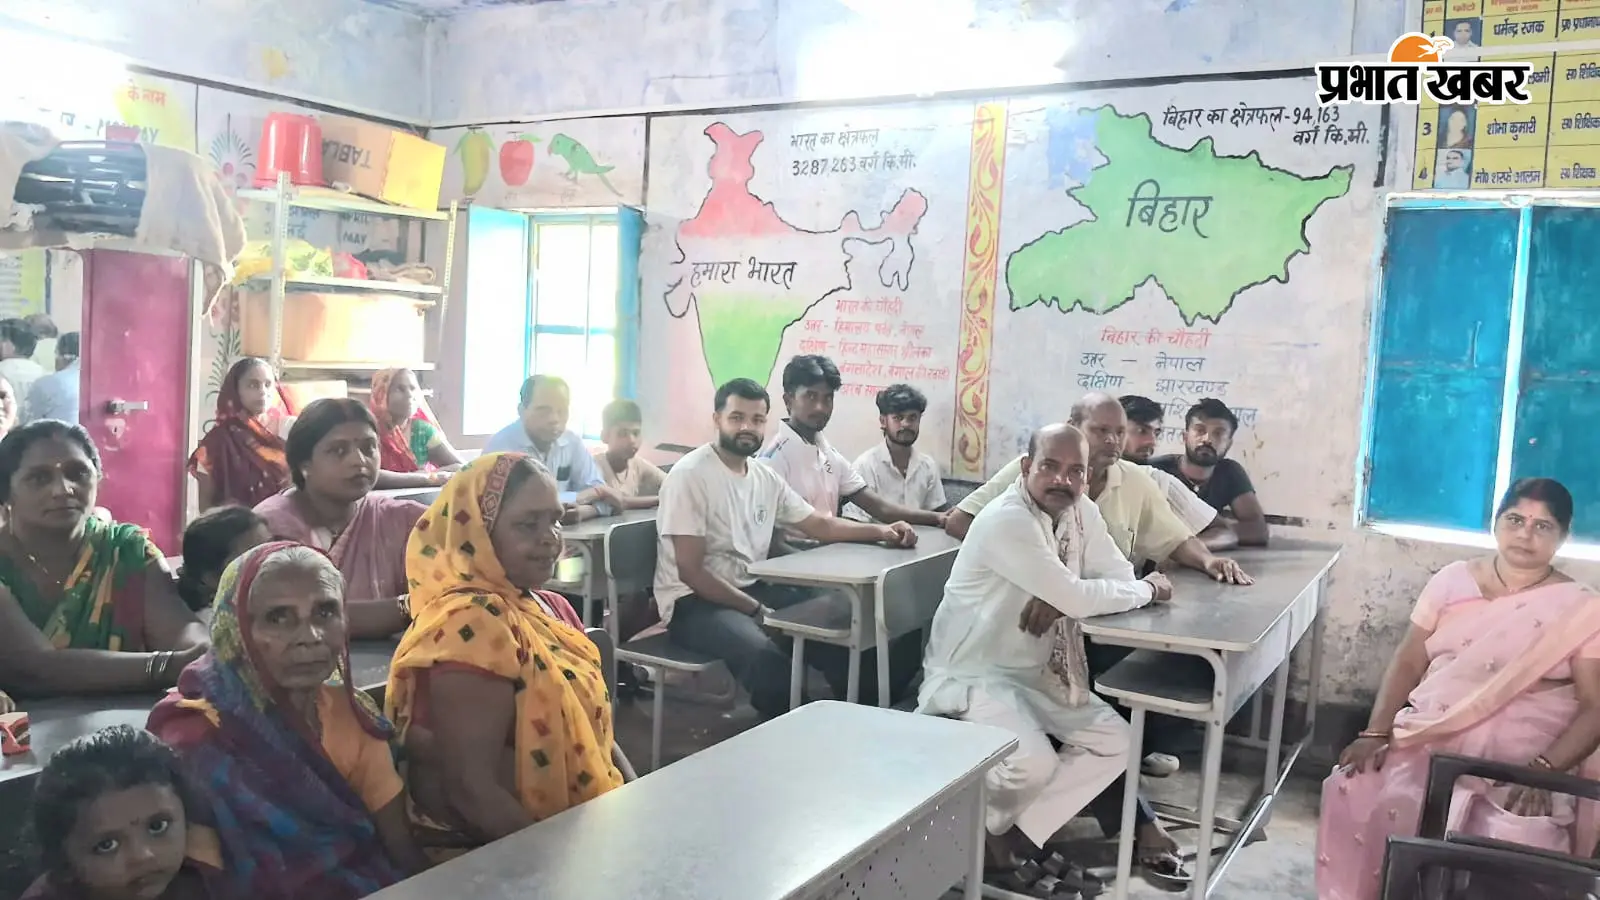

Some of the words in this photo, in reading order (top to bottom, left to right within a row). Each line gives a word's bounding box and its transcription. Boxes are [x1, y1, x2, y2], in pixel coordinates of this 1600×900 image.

[1163, 105, 1203, 130] बिहार
[1207, 107, 1228, 125] का
[1422, 122, 1432, 136] 3
[1509, 116, 1536, 140] कुमारी
[791, 133, 818, 151] भारत
[820, 132, 835, 146] का
[1126, 179, 1213, 238] बिहार
[691, 261, 741, 288] हमारा
[748, 256, 798, 290] भारत
[1100, 324, 1140, 347] बिहार
[1155, 351, 1206, 372] नेपाल
[1077, 370, 1125, 391] दक्षिण
